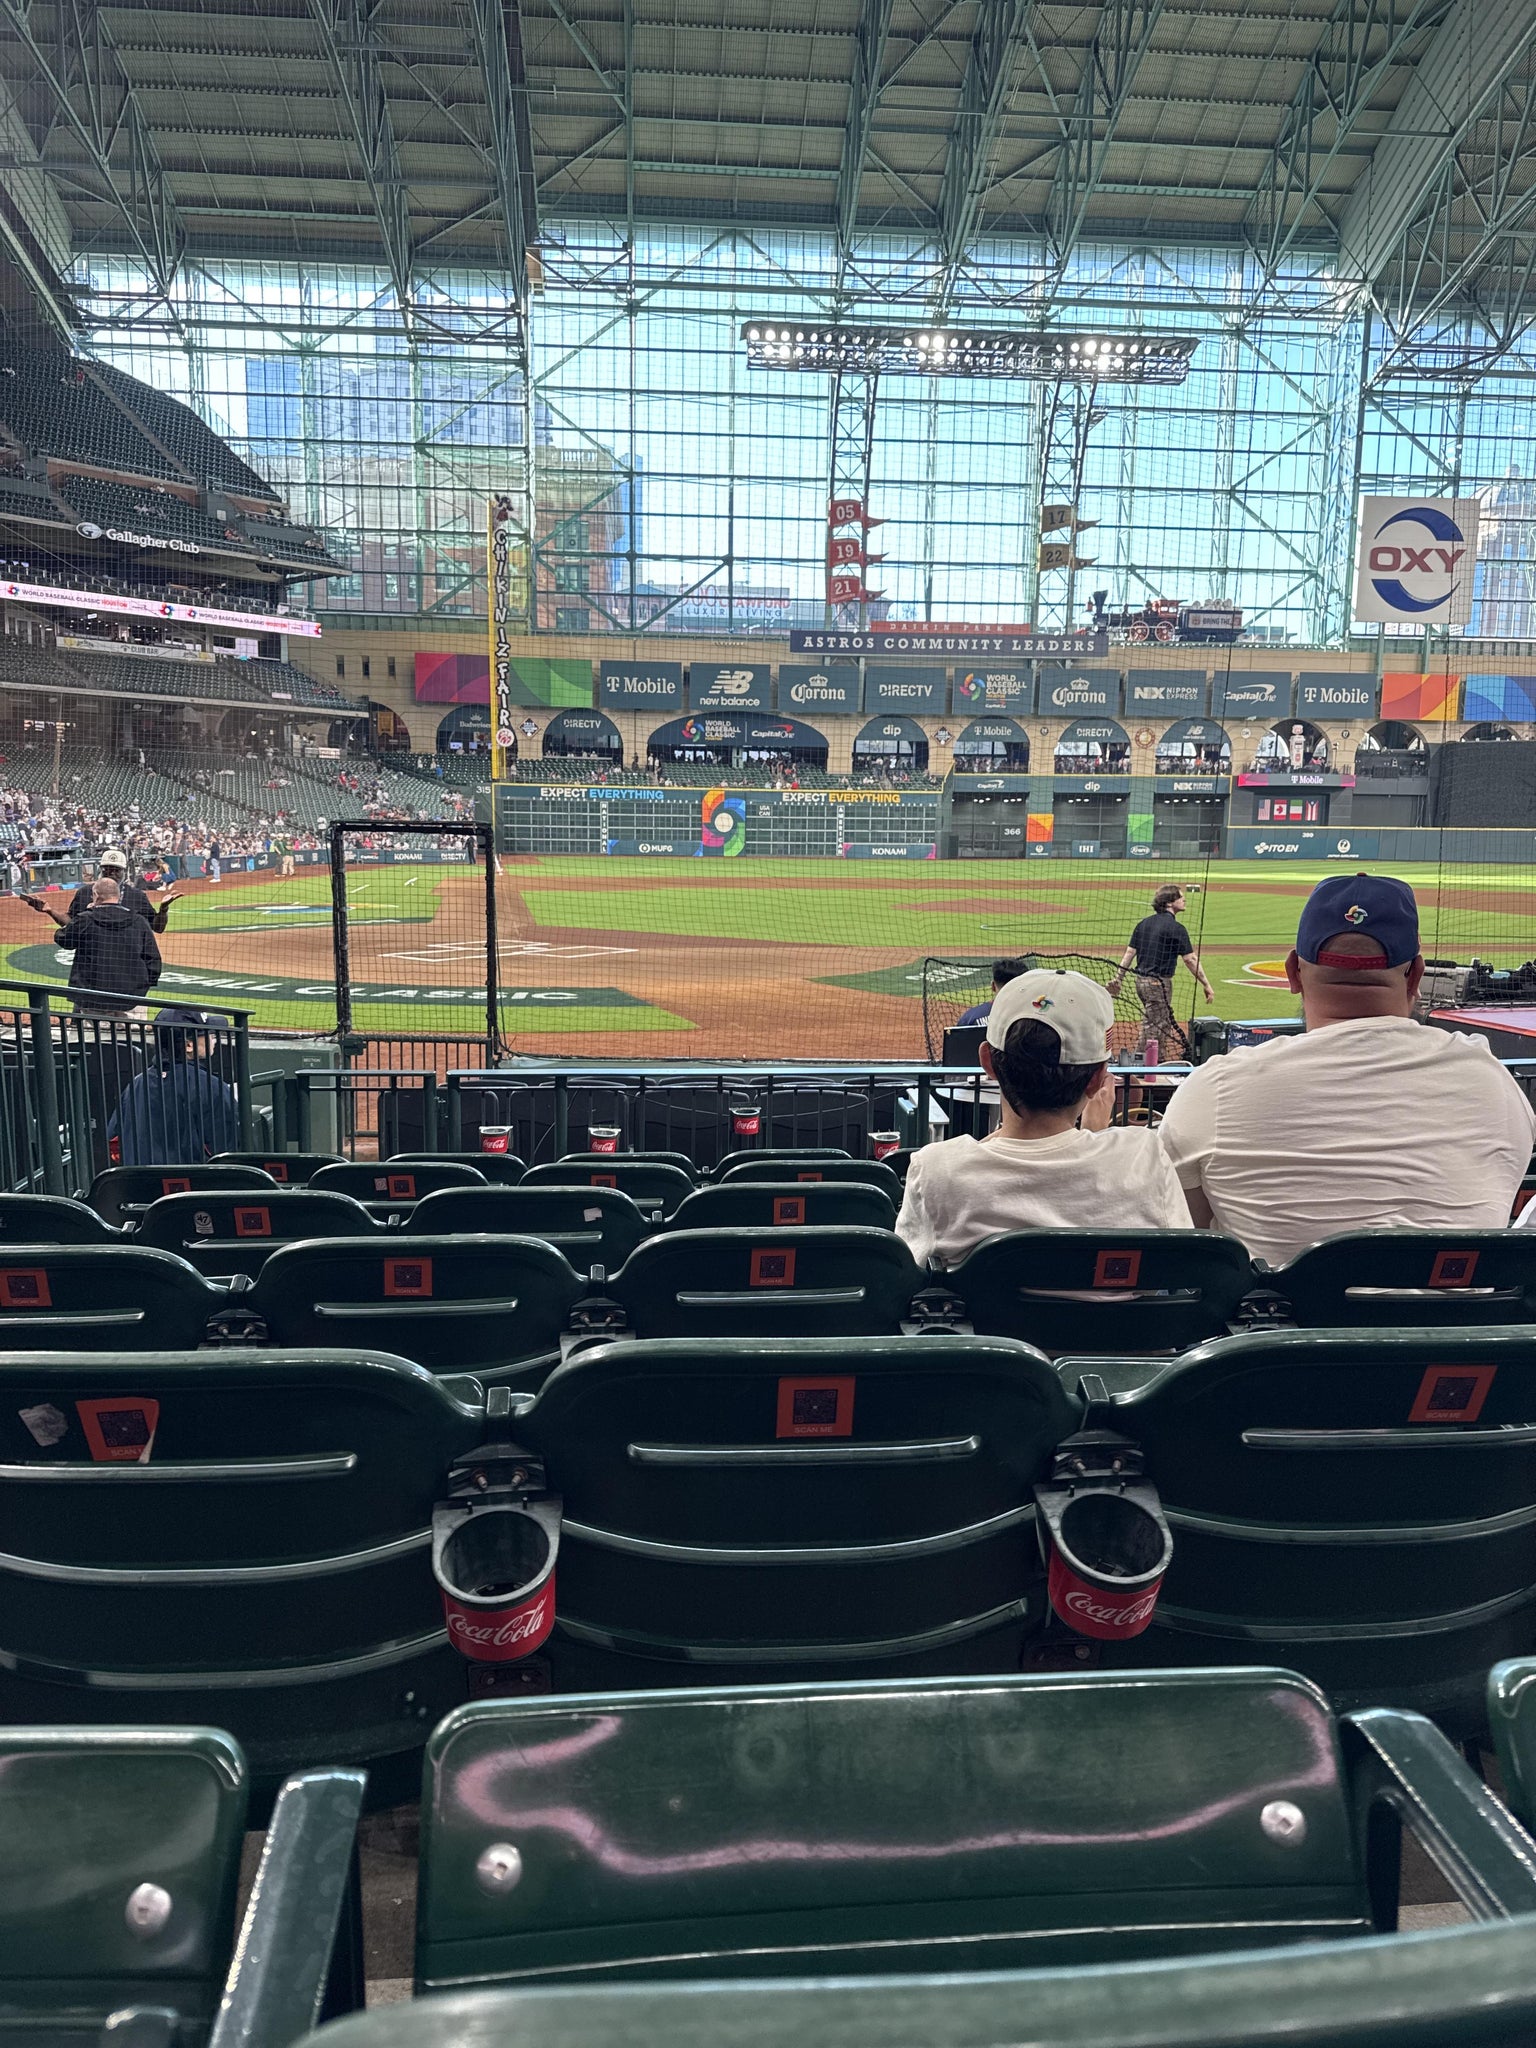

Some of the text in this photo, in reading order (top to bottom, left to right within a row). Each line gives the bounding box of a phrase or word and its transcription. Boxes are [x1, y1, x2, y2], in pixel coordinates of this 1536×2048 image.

[836, 505, 855, 520] 05
[1048, 510, 1065, 525] 17
[106, 528, 200, 554] Gallagher Club
[837, 544, 854, 559] 19
[1046, 551, 1063, 563] 22
[1369, 546, 1466, 574] OXY
[494, 529, 508, 623] CHIKIN
[835, 581, 851, 595] 21
[21, 589, 45, 598] WORLD
[45, 592, 75, 602] BASEBALL
[890, 623, 950, 631] DAIKIN
[803, 636, 1095, 651] ASTROS COMMUNITY LEADERS
[623, 677, 676, 694] Mobile
[879, 684, 933, 697] DIRECTV
[986, 687, 1020, 695] CLASSIC
[496, 662, 510, 726] FAIR
[791, 683, 846, 703] Corona
[1052, 687, 1106, 707] Corona
[1320, 688, 1369, 704] Mobile
[700, 696, 760, 707] new balance
[564, 718, 601, 729] DIRECTV
[883, 725, 901, 736] dip
[983, 726, 1012, 736] Mobile
[1077, 728, 1112, 738] DIRECTV
[1084, 781, 1101, 792] dip
[1299, 775, 1324, 785] Mobile
[476, 786, 491, 794] 315
[541, 787, 664, 800] EXPECT EVERYTHING
[782, 792, 900, 803] EXPECT EVERYTHING
[1004, 828, 1021, 836] 366
[872, 848, 907, 856] KONAMI
[1268, 844, 1299, 853] ITO EN
[448, 1594, 547, 1647] Coca-Cola
